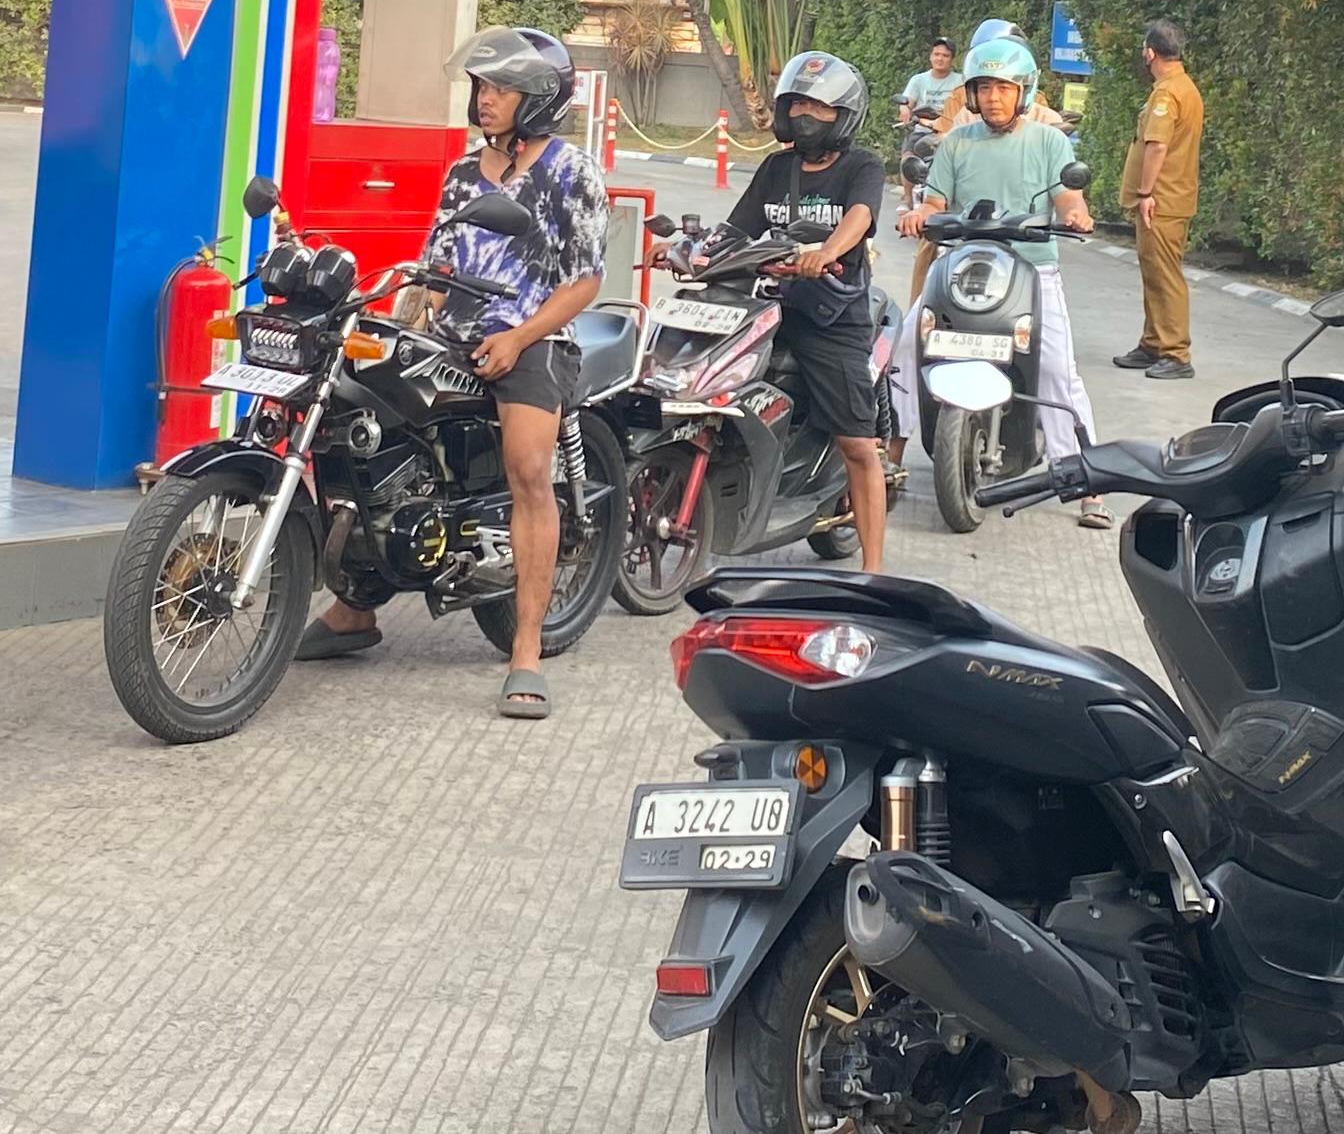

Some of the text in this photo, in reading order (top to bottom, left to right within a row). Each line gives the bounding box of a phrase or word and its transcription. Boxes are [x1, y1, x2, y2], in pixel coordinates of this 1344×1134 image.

[966, 660, 1065, 691] NMAX
[642, 800, 657, 836] A
[673, 798, 736, 834] 3242
